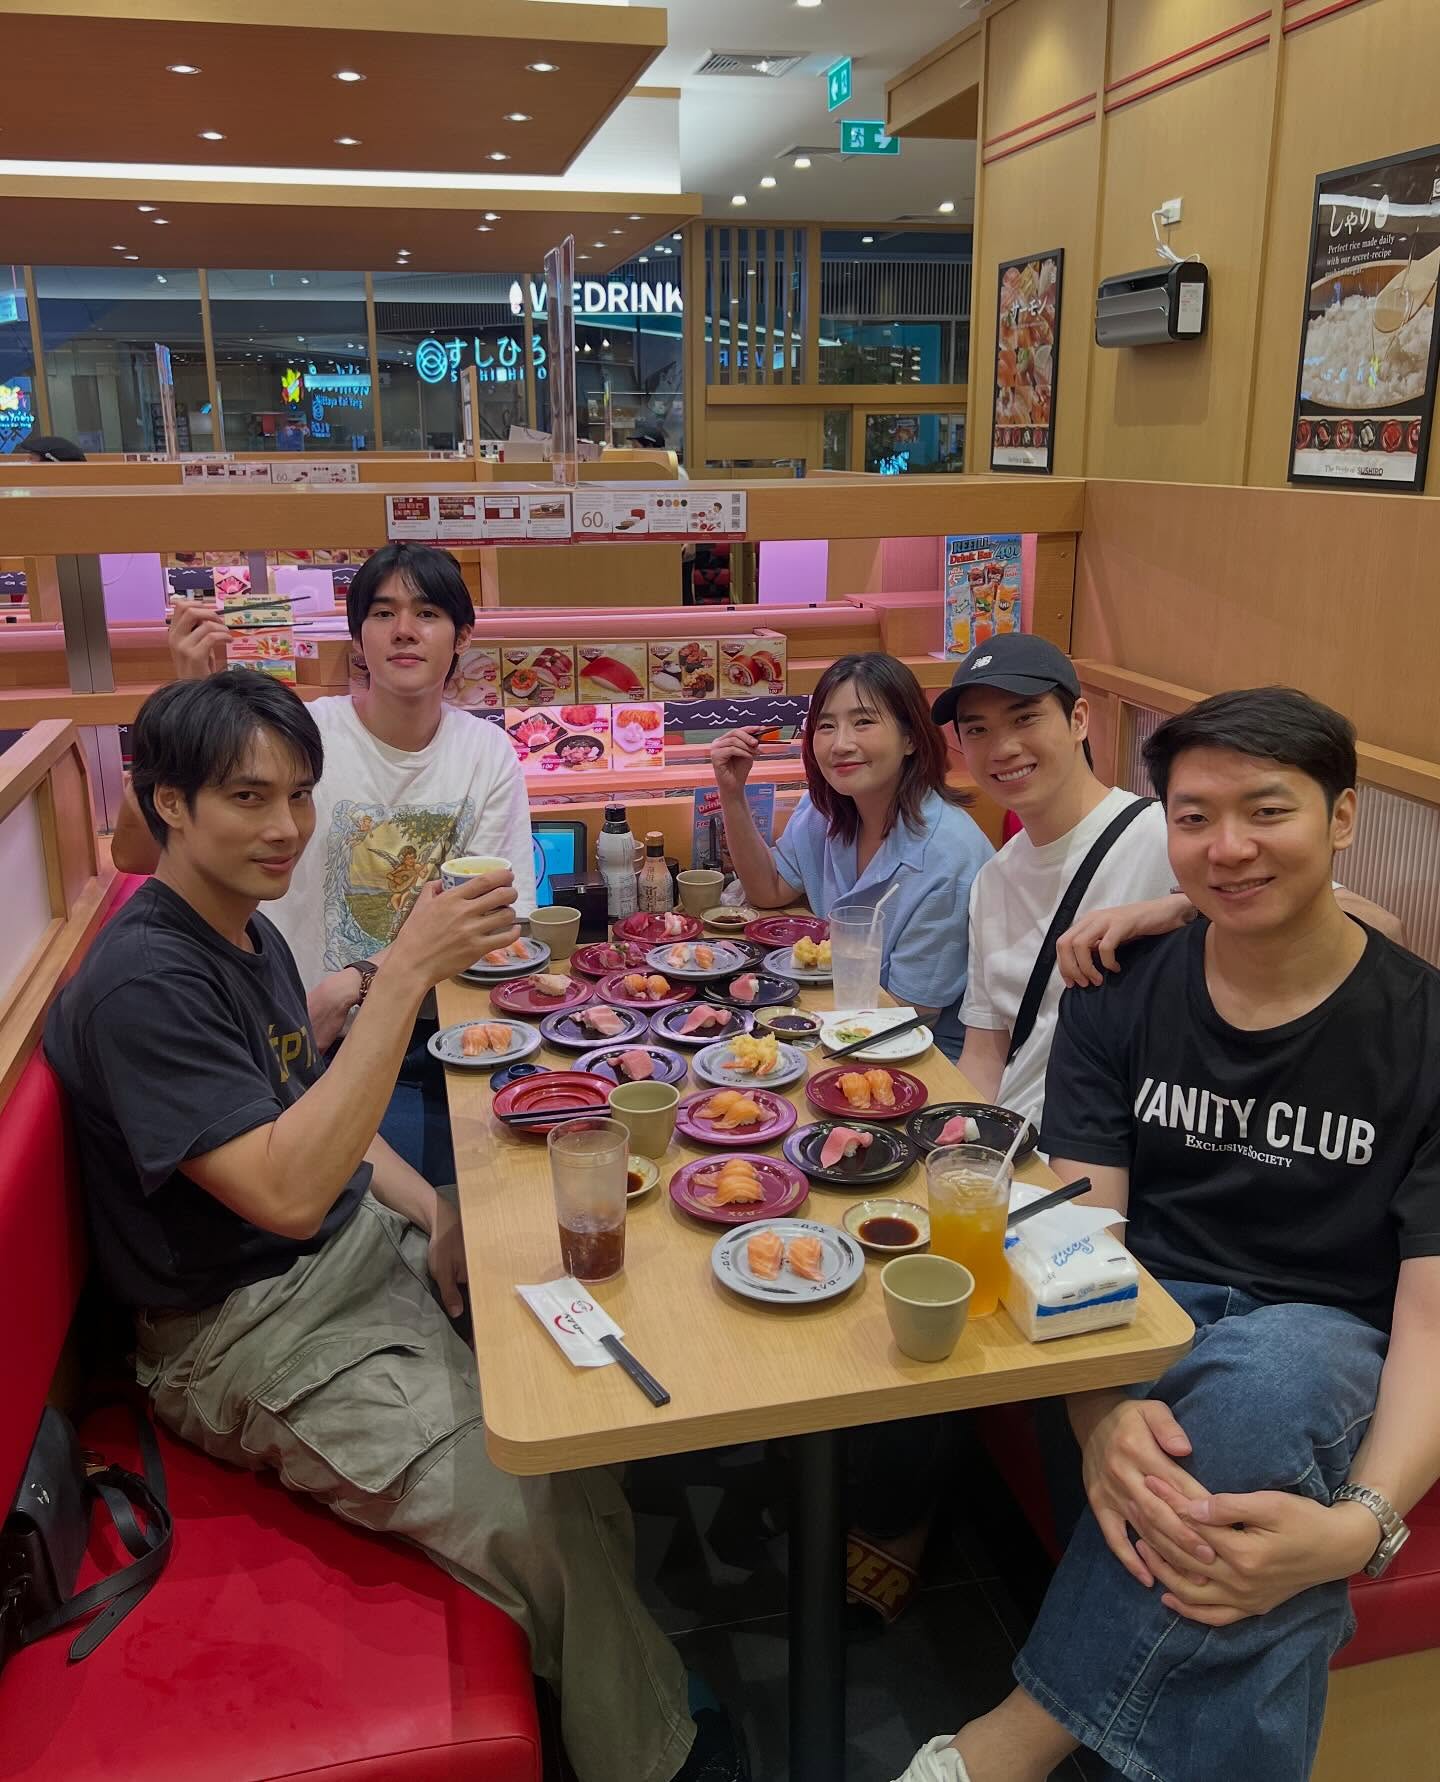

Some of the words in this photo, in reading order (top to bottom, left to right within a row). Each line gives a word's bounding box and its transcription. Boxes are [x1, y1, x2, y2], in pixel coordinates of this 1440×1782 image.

[1330, 199, 1372, 237] しゃり
[1328, 244, 1348, 254] Perfect
[1349, 241, 1361, 250] rice
[1362, 237, 1378, 248] made
[1379, 234, 1395, 245] daily
[1327, 257, 1340, 266] with
[1357, 466, 1384, 477] SUSHIRO
[581, 511, 603, 528] 60
[1266, 1101, 1376, 1166] CLUB
[809, 1276, 842, 1293] スシロー
